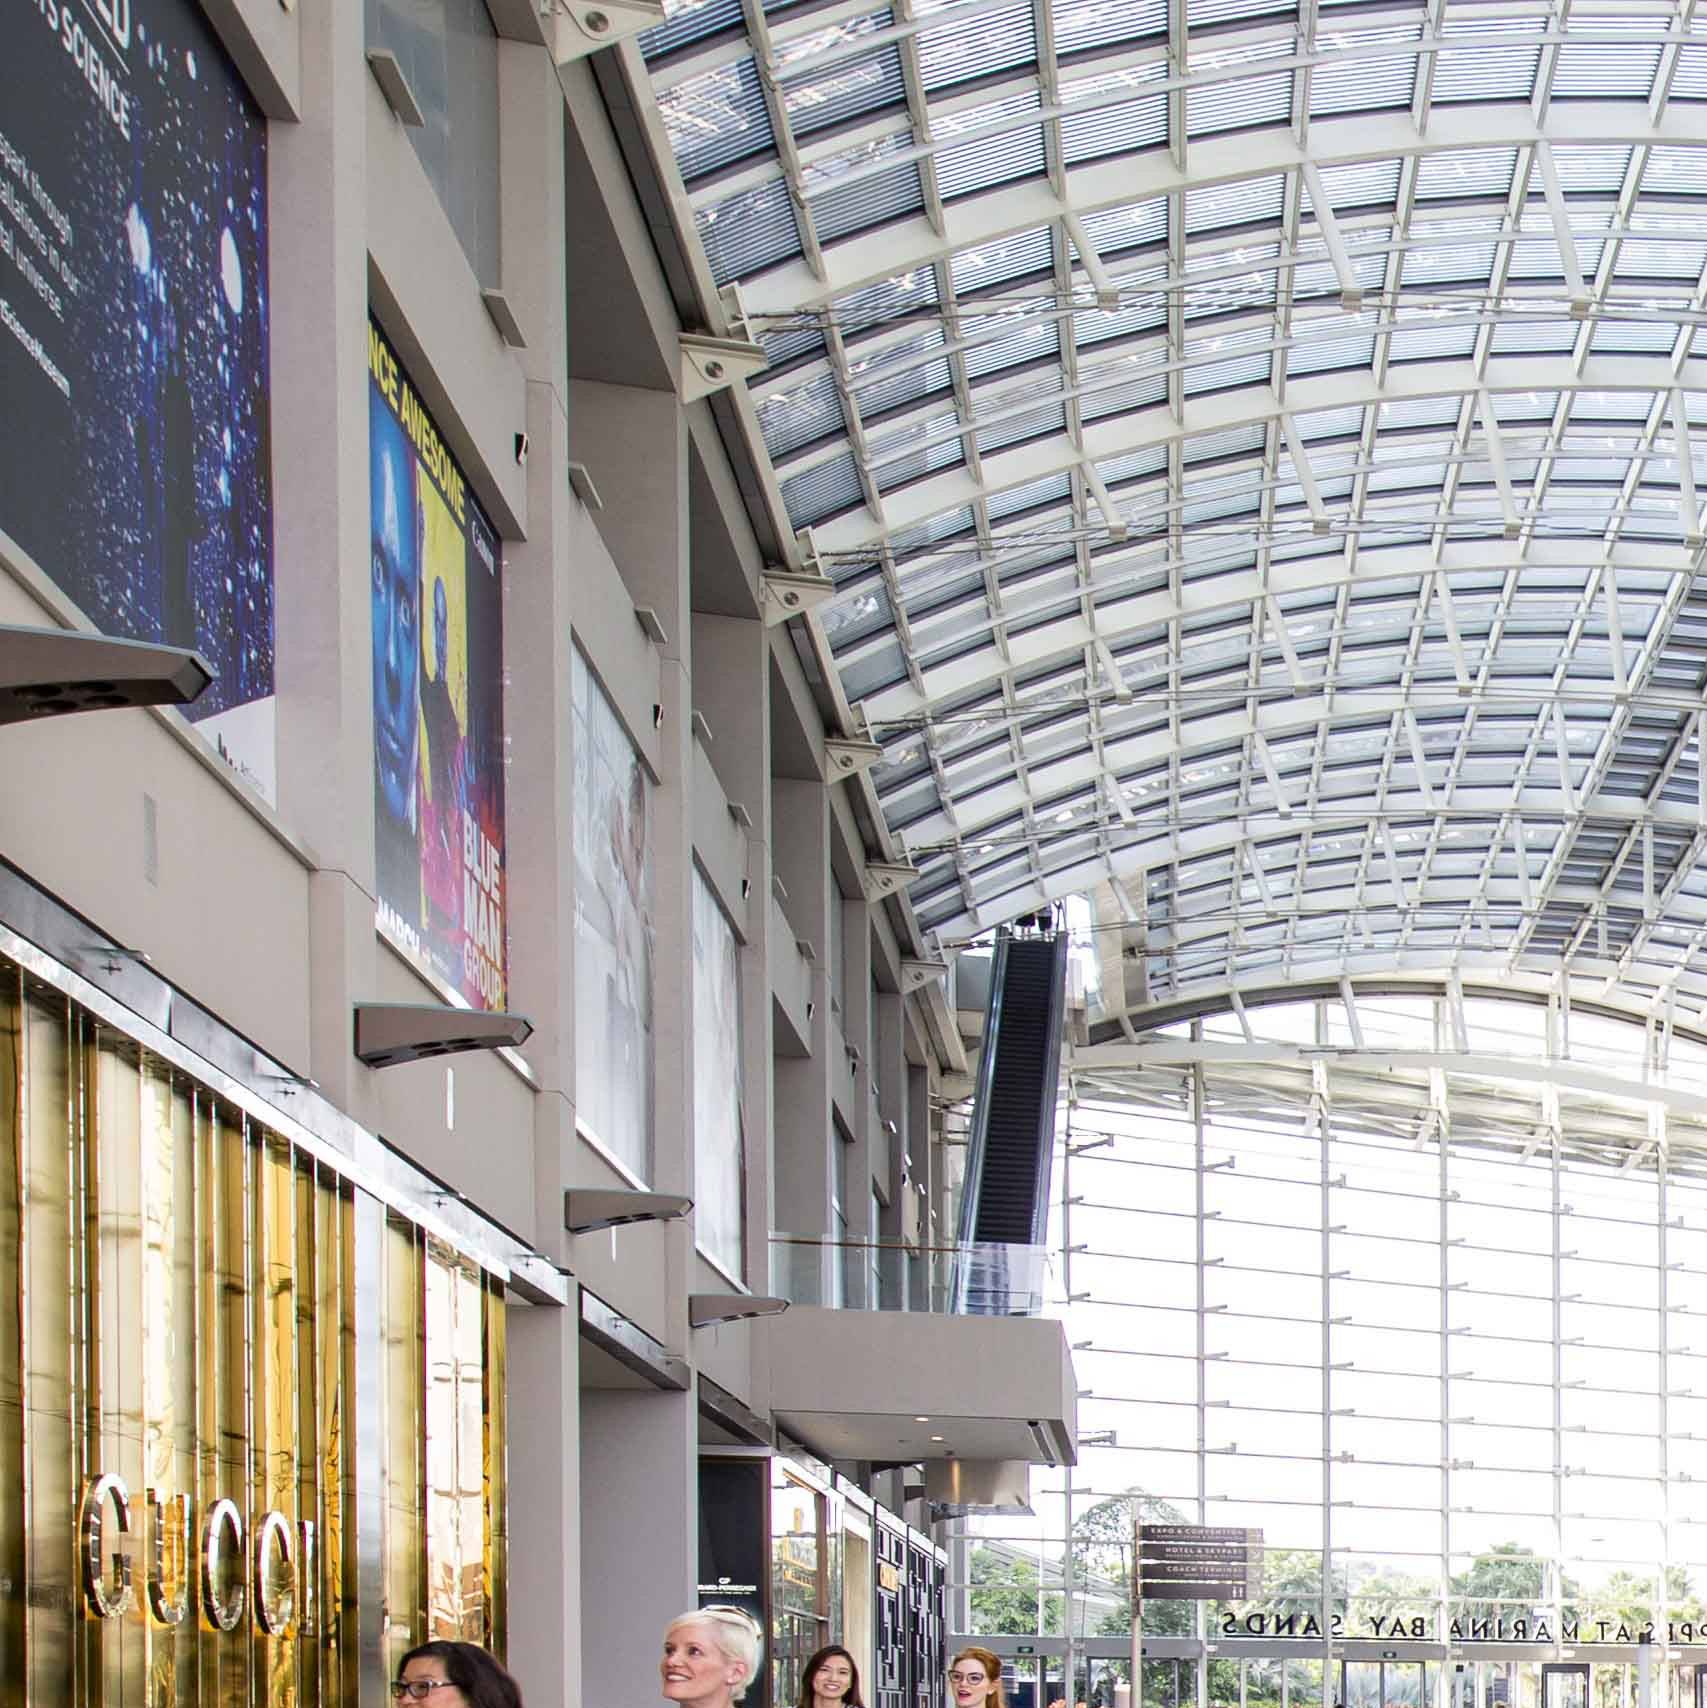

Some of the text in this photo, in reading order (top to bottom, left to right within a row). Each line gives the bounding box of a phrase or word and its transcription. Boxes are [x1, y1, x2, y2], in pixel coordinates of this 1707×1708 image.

[62, 5, 131, 142] SCIENCE
[400, 379, 466, 526] AWESOME
[463, 807, 501, 900] BLUE
[463, 868, 501, 971] MAN
[463, 938, 501, 1010] GROUP
[80, 1472, 315, 1637] GUCCI
